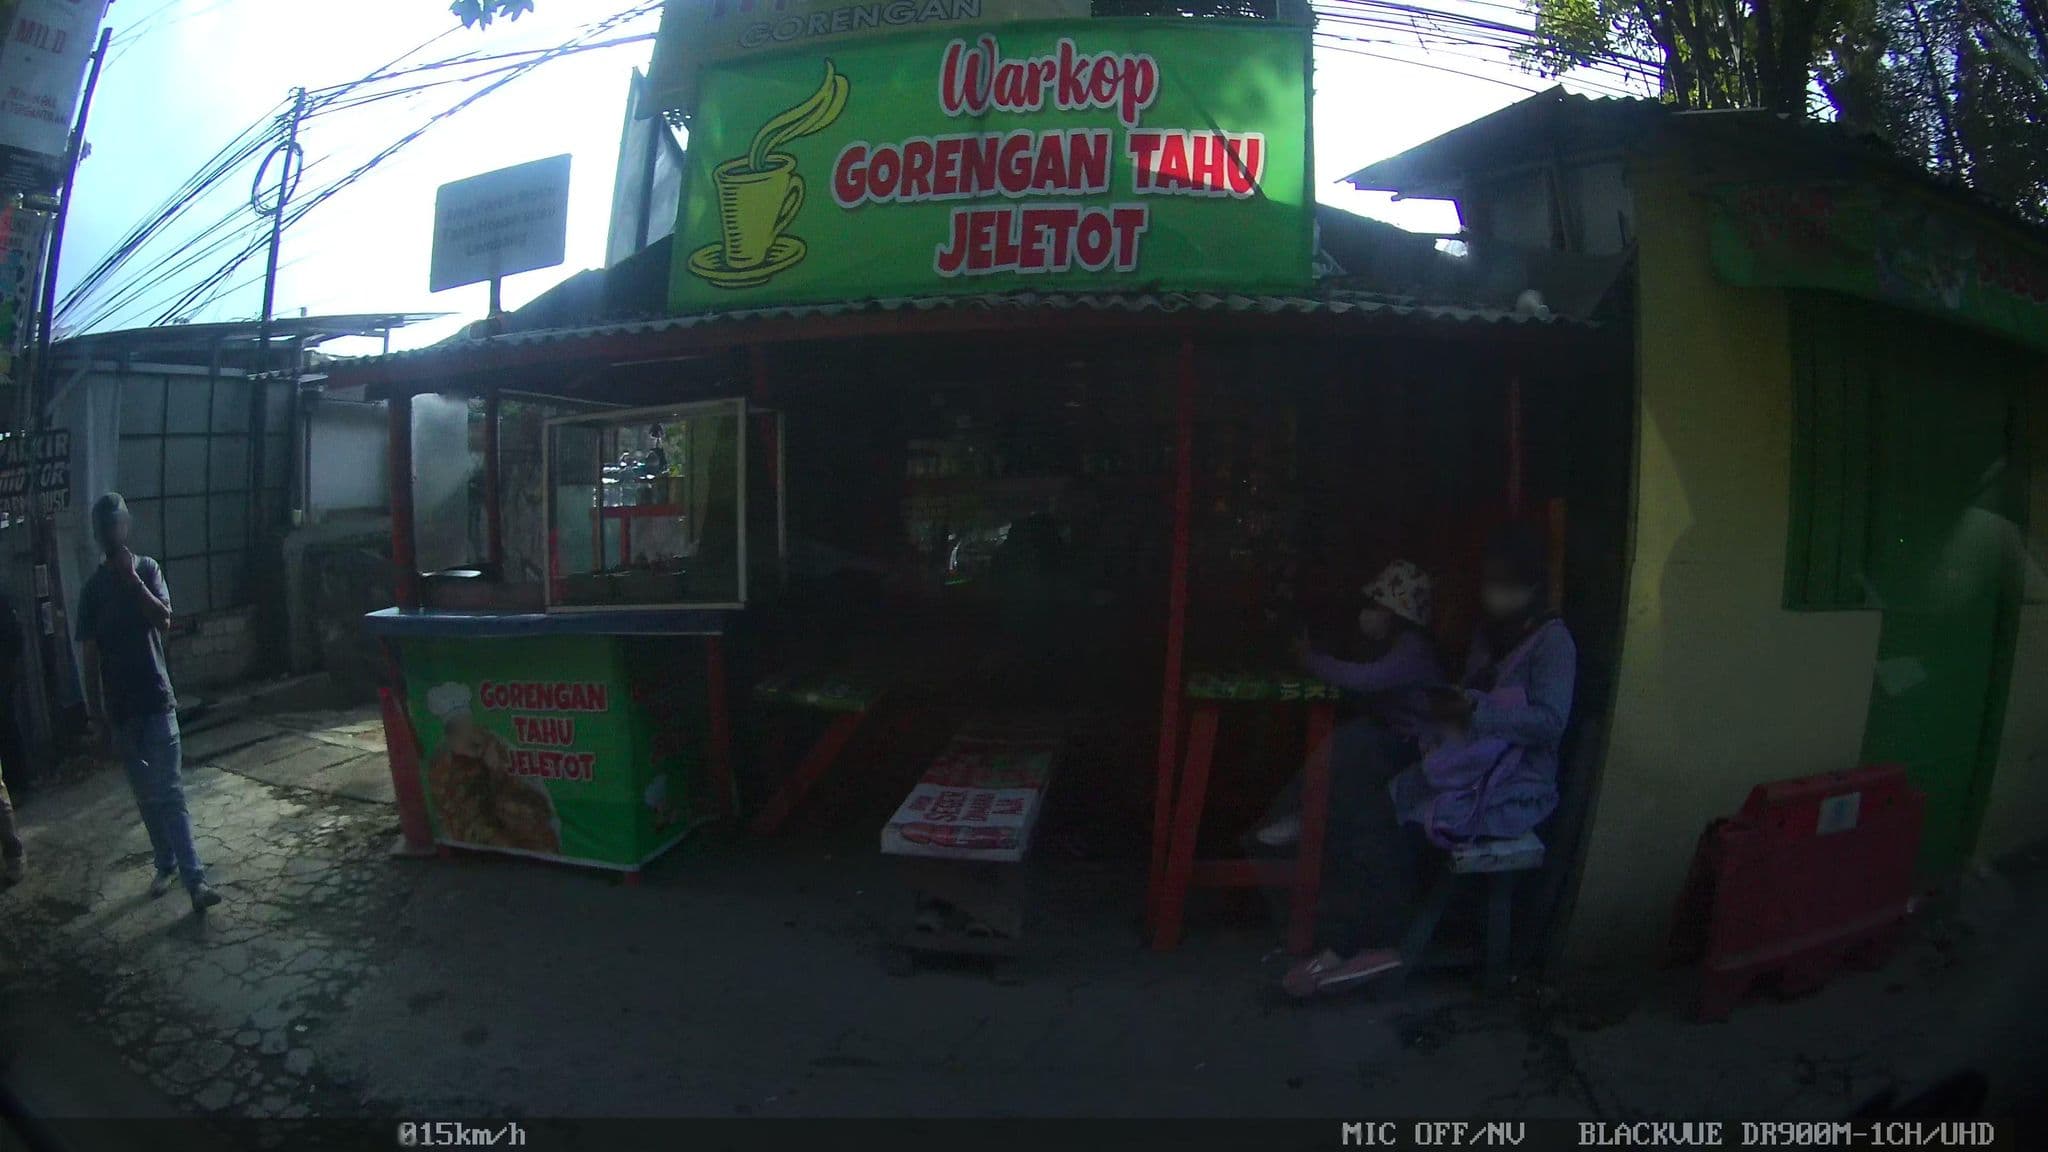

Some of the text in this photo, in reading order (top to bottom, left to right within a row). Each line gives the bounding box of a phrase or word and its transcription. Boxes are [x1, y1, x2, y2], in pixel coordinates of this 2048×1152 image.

[738, 0, 982, 49] GORENGAN
[941, 37, 1157, 125] Warkop
[833, 130, 1264, 206] GORENGAN TAHU
[936, 203, 1146, 274] JELETOT
[480, 680, 608, 712] GORENGAN
[512, 714, 575, 746] TAHU
[508, 750, 597, 781] JELETOT
